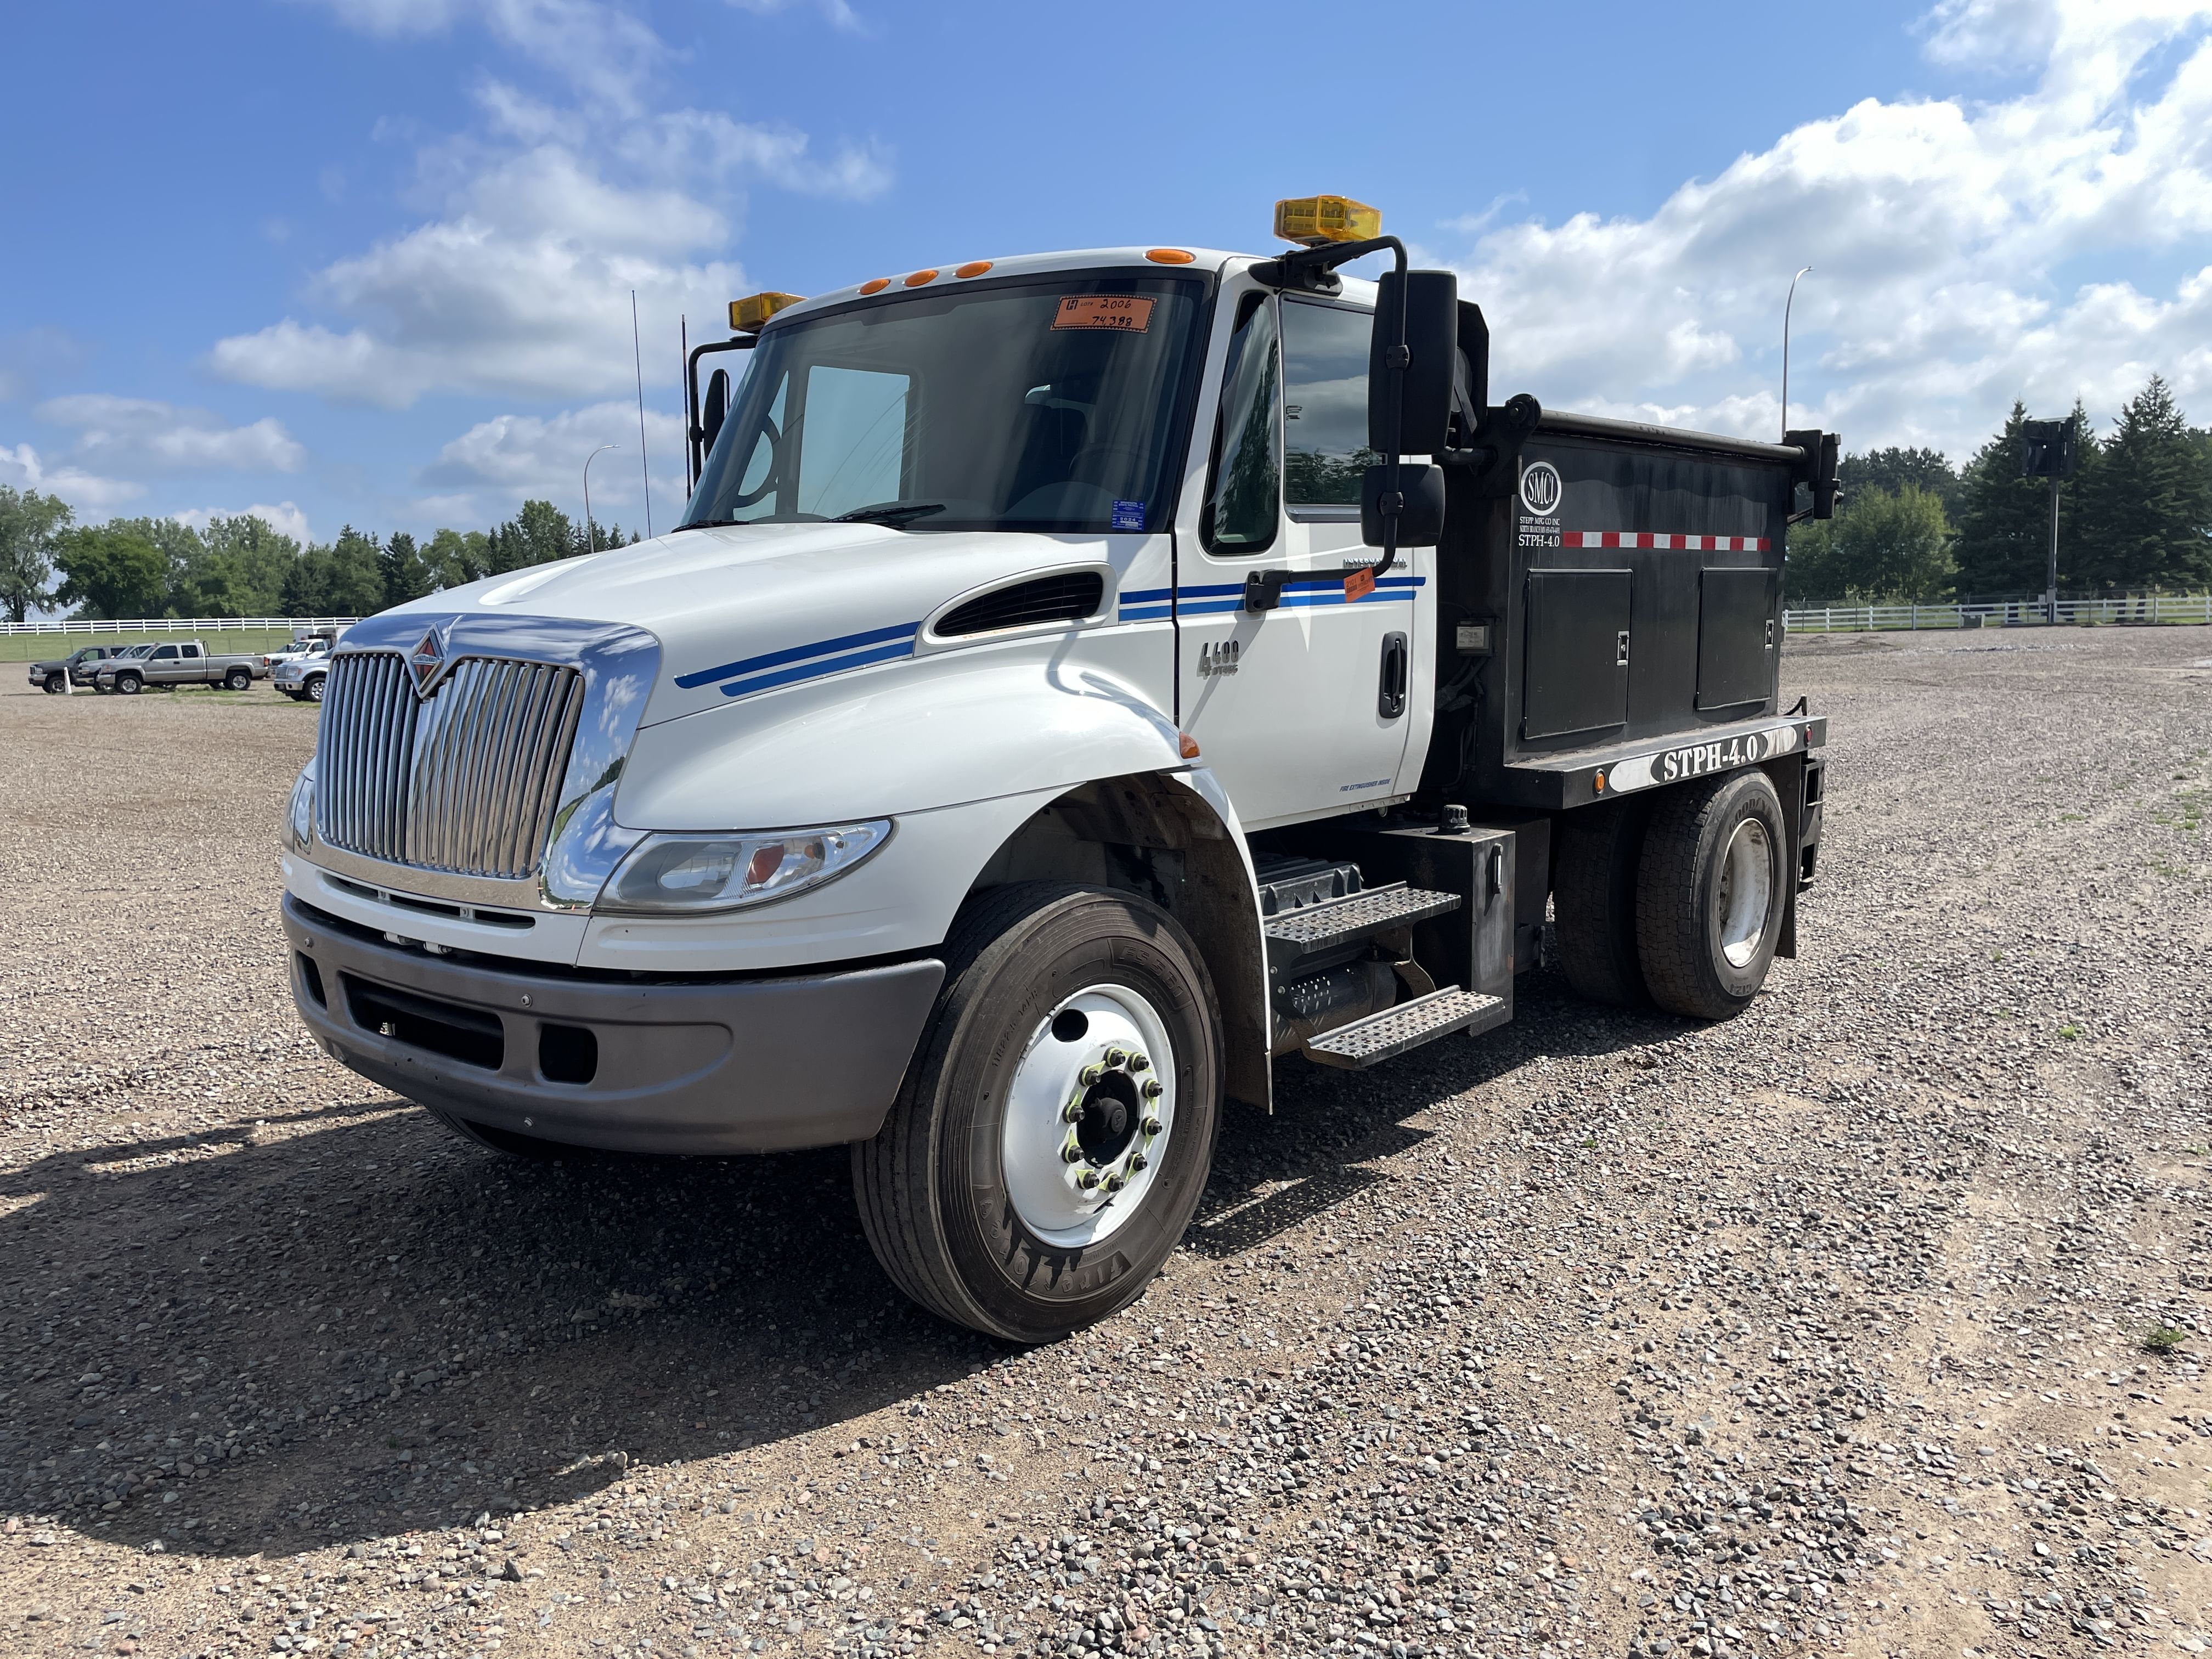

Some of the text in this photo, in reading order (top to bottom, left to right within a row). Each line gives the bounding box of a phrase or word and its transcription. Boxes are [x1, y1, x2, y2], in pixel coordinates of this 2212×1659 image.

[1100, 298, 1132, 309] 2006
[1092, 316, 1133, 327] 74,388
[1528, 472, 1554, 504] SMCI
[1519, 516, 1534, 524] STEPP
[1534, 517, 1544, 525] MFG
[1518, 534, 1560, 547] STPH-4.0
[1343, 557, 1408, 569] INTERNANAL
[1198, 640, 1239, 676] 4400
[1664, 735, 1758, 782] STPH-4.0
